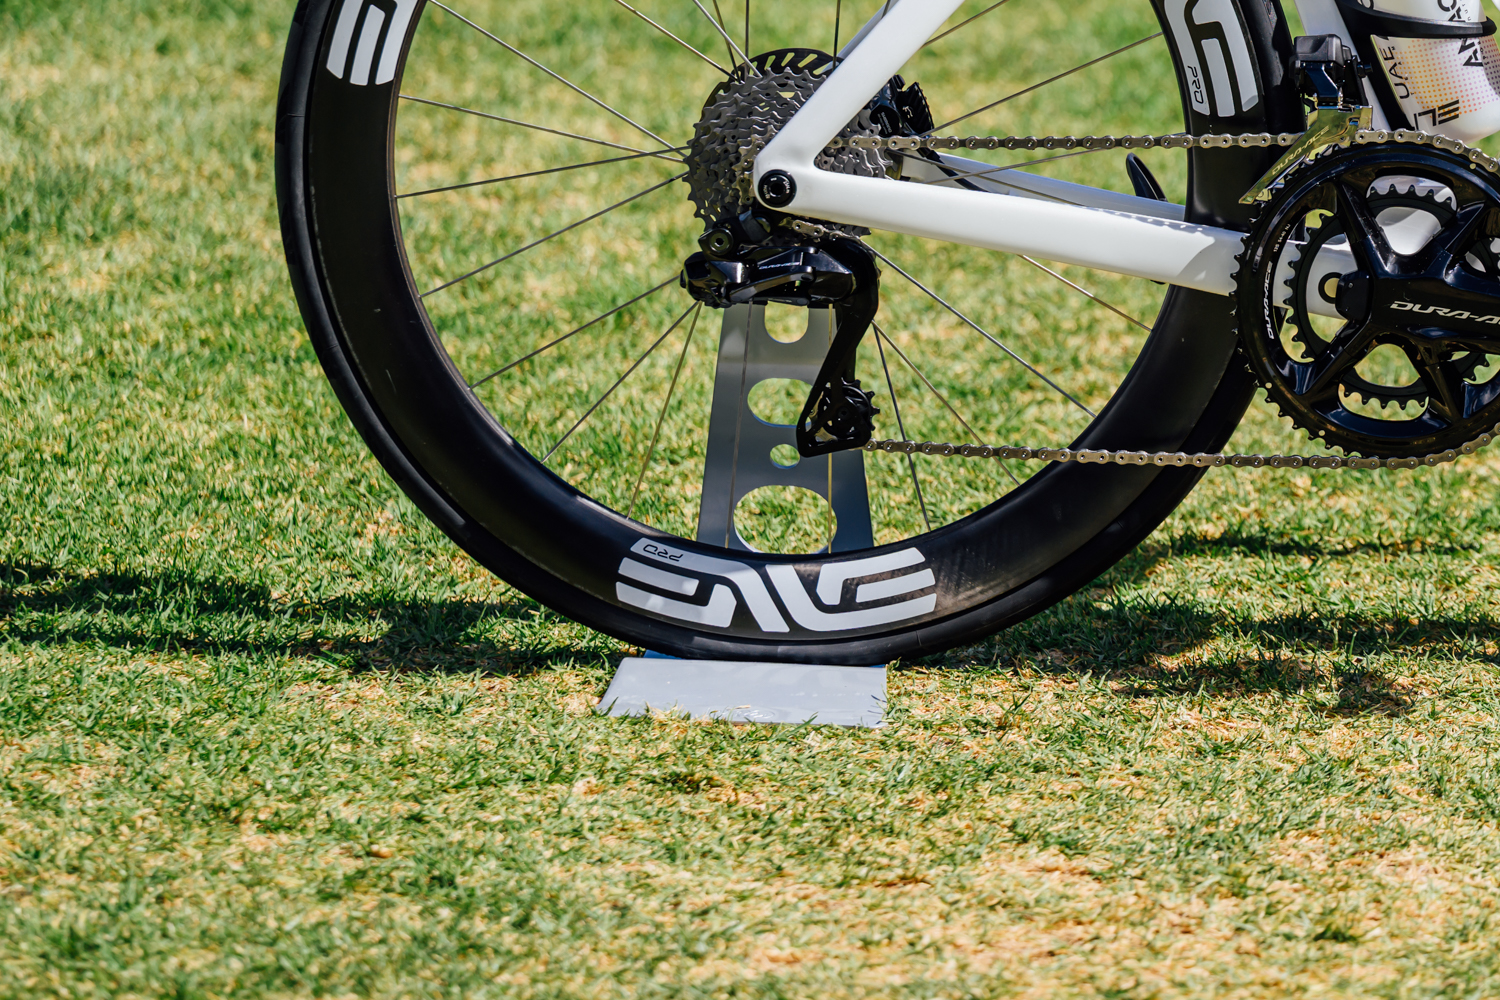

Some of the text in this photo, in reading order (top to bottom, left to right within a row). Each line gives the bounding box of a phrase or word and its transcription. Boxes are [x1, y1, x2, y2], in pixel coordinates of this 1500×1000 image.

[1187, 65, 1204, 104] PRO
[1379, 46, 1410, 99] UAE
[1271, 124, 1329, 176] DURA-ACE
[1263, 260, 1275, 340] DURA-ACE
[643, 543, 684, 562] PRO
[615, 537, 937, 633] ENVE
